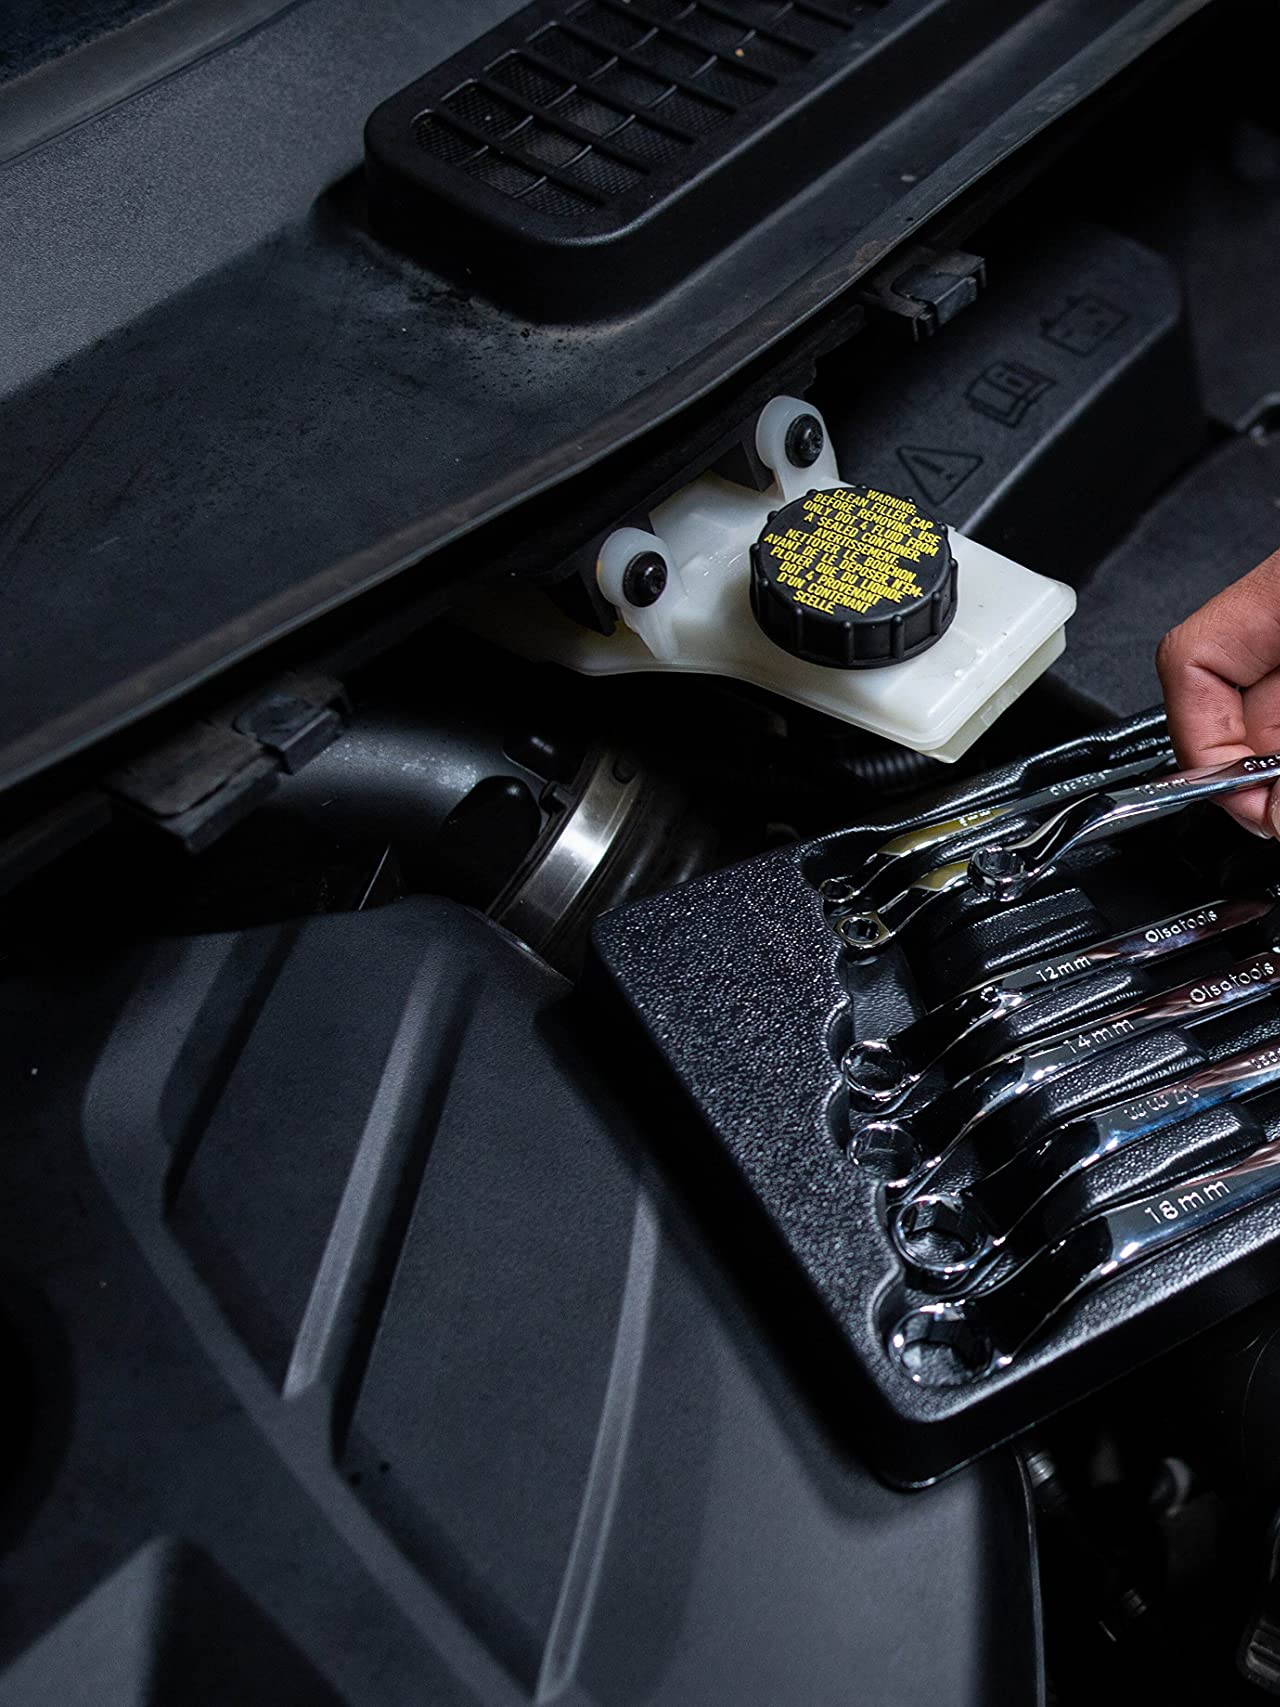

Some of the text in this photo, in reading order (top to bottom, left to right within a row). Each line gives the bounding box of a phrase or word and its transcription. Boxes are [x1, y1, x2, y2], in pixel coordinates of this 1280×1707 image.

[804, 512, 814, 522] A
[817, 517, 858, 538] SEALED
[813, 493, 855, 514] BEFORE
[918, 531, 942, 546] USE
[833, 489, 934, 530] CLEAN FILLER CAP
[867, 490, 916, 515] WARNING:
[763, 533, 802, 551] AVANT
[802, 546, 820, 558] DE
[821, 553, 838, 565] LE
[803, 500, 939, 556] ONLY DOT 4 FLUID FROM
[770, 546, 905, 603] PLOYER QUE DU LIQUIDE
[785, 528, 916, 583] NETTOYER LE BOUCHON
[779, 561, 882, 605] DOT 4 PROVENANT
[807, 583, 872, 613] CONTENANT
[1036, 956, 1092, 983] 12mm
[1145, 908, 1219, 944] Olsatools
[1063, 1017, 1134, 1056] 14mm
[1189, 960, 1276, 1004] Olsatools
[1145, 1179, 1232, 1227] 18mm
